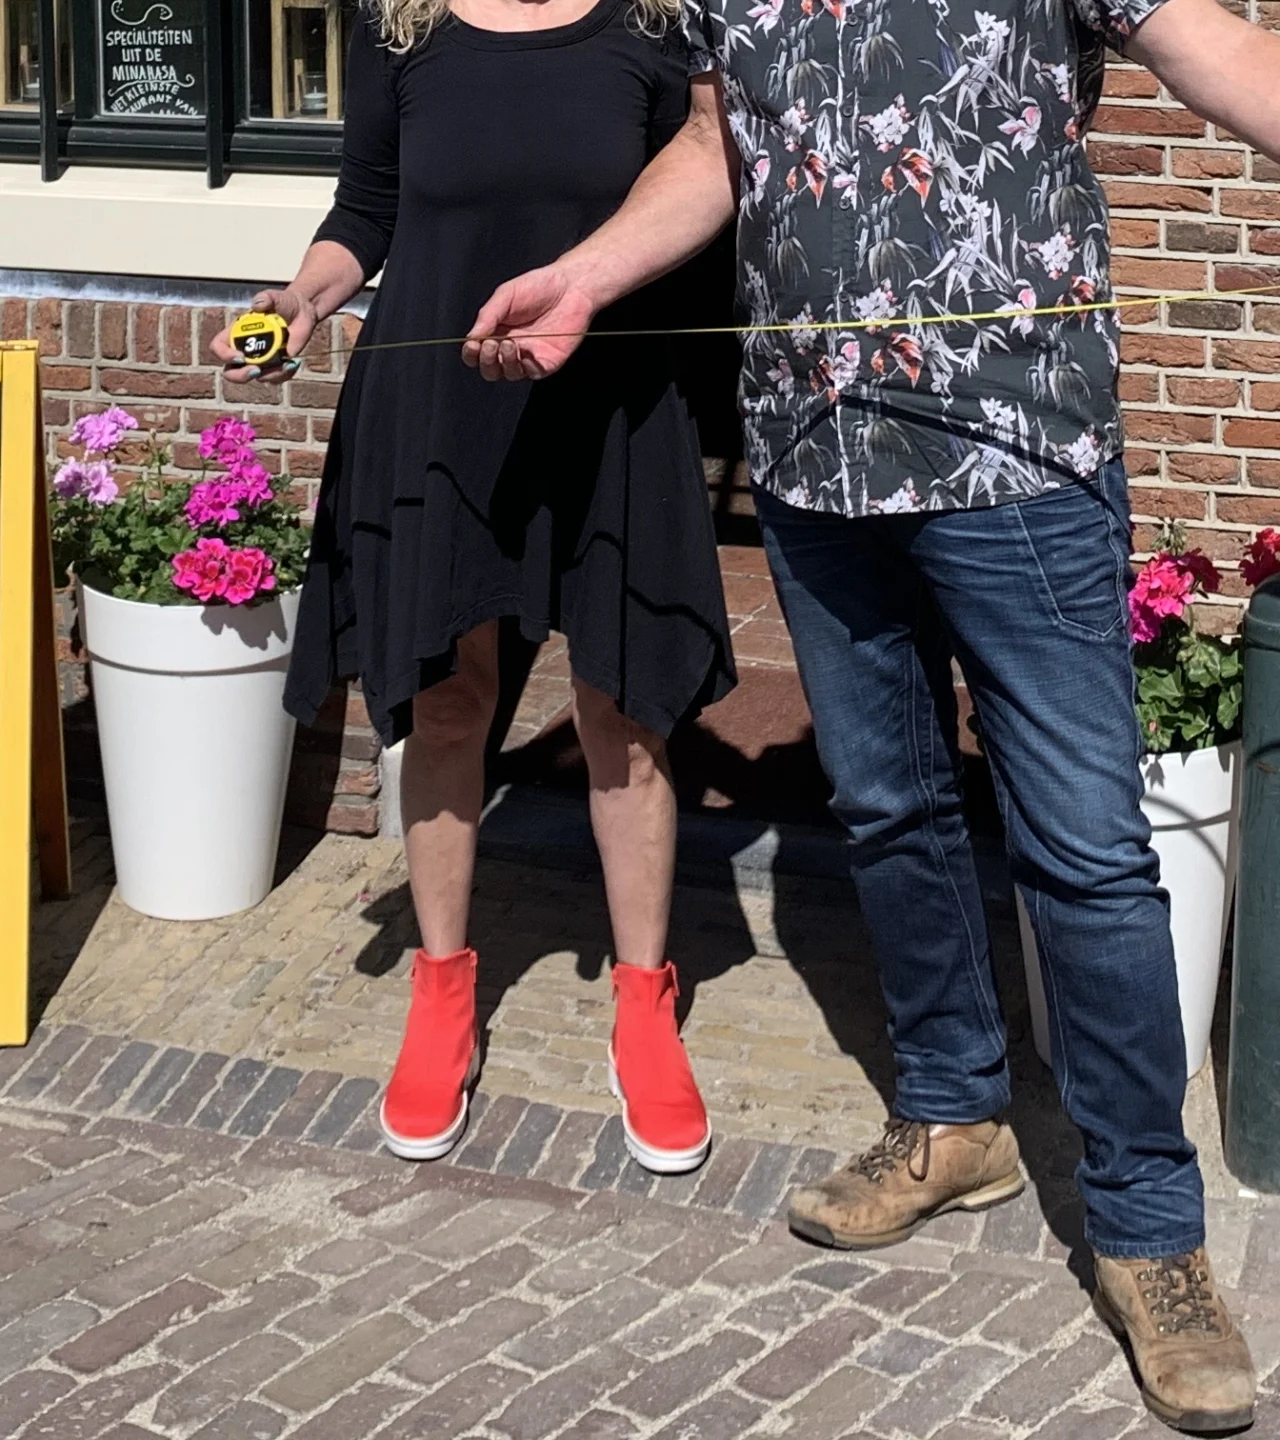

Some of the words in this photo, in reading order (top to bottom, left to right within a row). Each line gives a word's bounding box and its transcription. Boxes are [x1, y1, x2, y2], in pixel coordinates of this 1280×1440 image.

[105, 26, 193, 47] SPECIALITEITEN
[122, 48, 141, 62] UIT
[145, 48, 162, 62] DE
[112, 65, 177, 81] MINAHASA
[110, 96, 129, 113] HET
[124, 82, 180, 101] KLEINSTE
[175, 99, 198, 116] VAN
[245, 337, 266, 352] 3m
